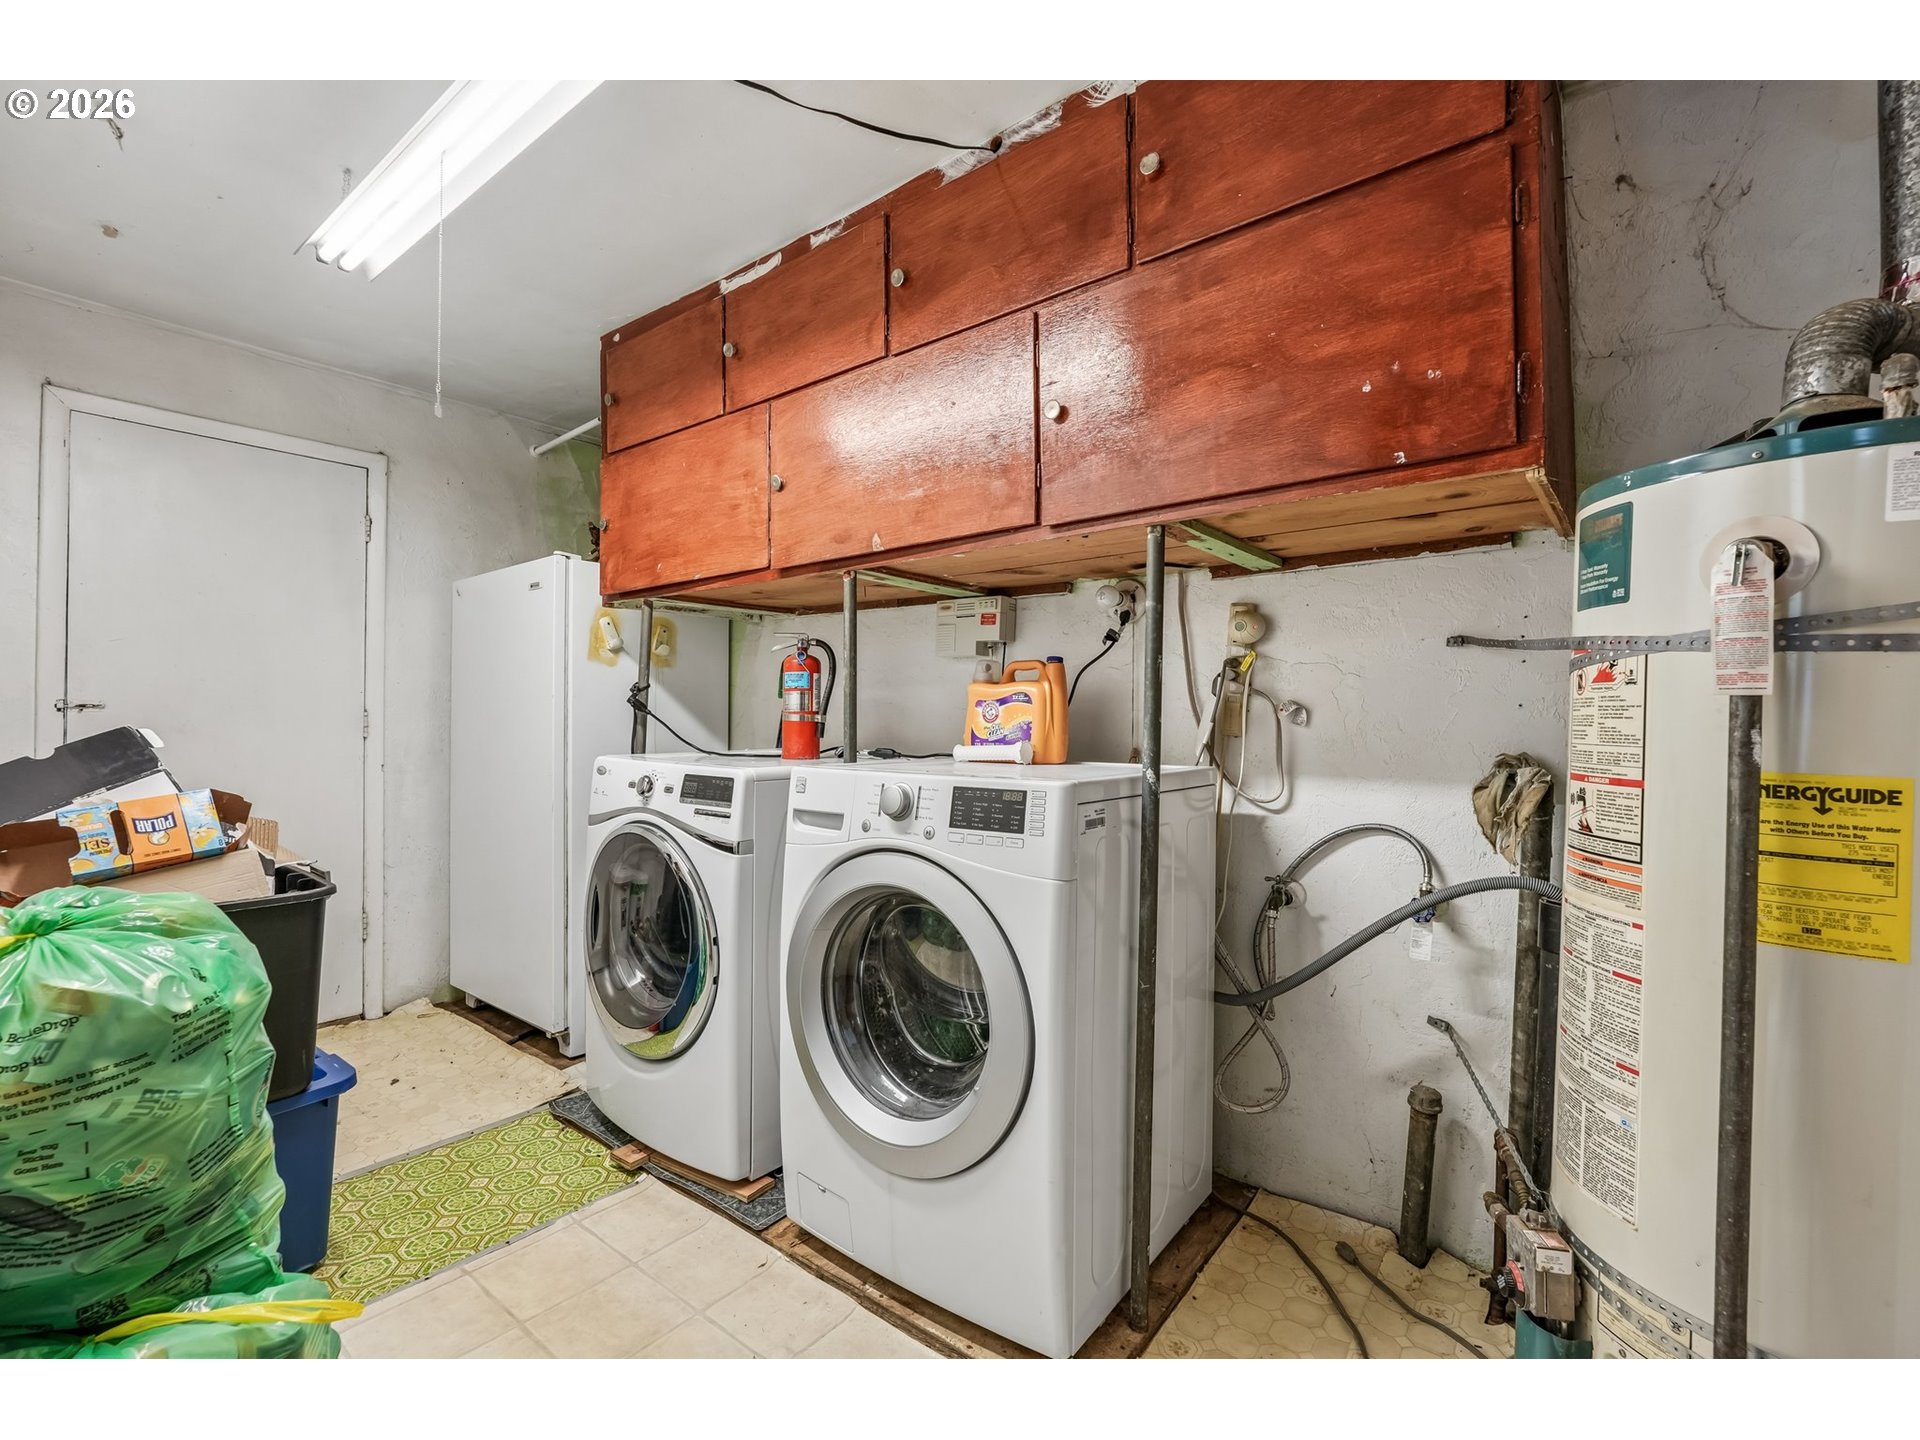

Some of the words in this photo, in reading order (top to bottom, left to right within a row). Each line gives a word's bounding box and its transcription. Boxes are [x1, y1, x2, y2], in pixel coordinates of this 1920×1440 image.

[1760, 783, 1903, 808] NERGYGUIDE
[136, 814, 175, 834] POLAR
[1786, 820, 1810, 829] Energy
[1876, 826, 1901, 834] Heater
[1787, 827, 1810, 836] Others
[1853, 833, 1869, 841] Buy.
[172, 1010, 192, 1022] Tag
[6, 1014, 80, 1043] BoleDrop
[4, 1088, 29, 1100] links
[32, 1082, 52, 1092] this
[55, 1076, 73, 1087] bag
[88, 1064, 110, 1078] your
[21, 1095, 47, 1107] keep
[50, 1088, 73, 1101] your
[75, 1071, 126, 1092] containers
[128, 1060, 156, 1074] inside.
[5, 1112, 18, 1120] us
[21, 1106, 49, 1117] know
[52, 1101, 70, 1111] you
[73, 1087, 113, 1104] dropped
[14, 1165, 39, 1176] Goes
[41, 1162, 64, 1172] Here
